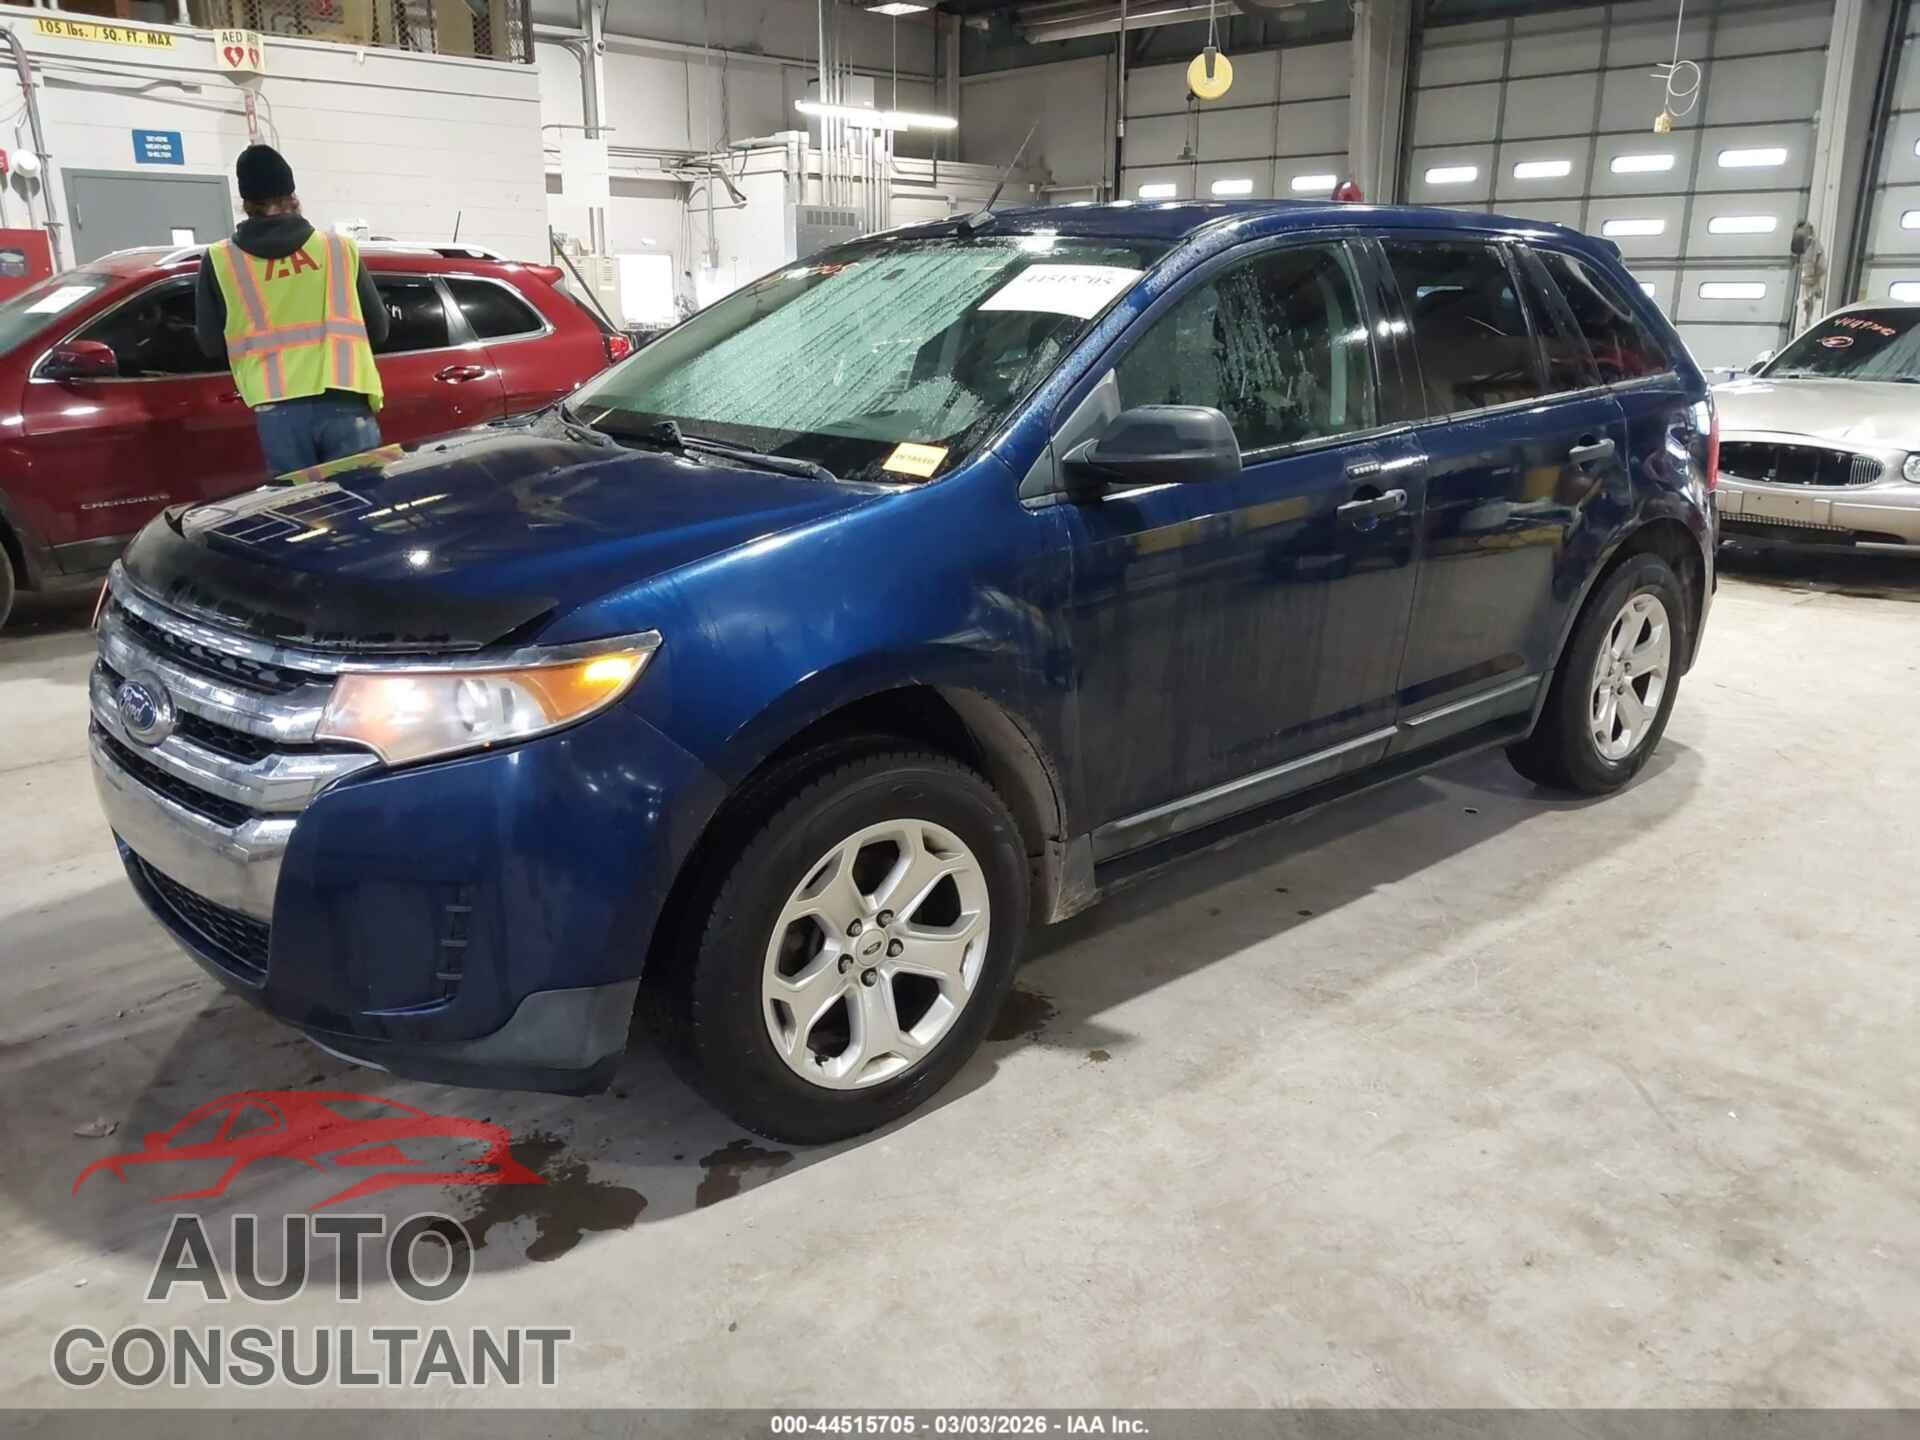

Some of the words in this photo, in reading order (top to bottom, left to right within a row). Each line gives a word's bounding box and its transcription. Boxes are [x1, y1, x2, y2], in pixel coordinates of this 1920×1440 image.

[39, 20, 62, 34] 105
[67, 23, 89, 38] lbs.
[103, 28, 121, 41] SQ.
[126, 31, 143, 43] FT.
[147, 33, 172, 47] MAX
[222, 31, 243, 43] AED
[121, 686, 151, 722] Ford
